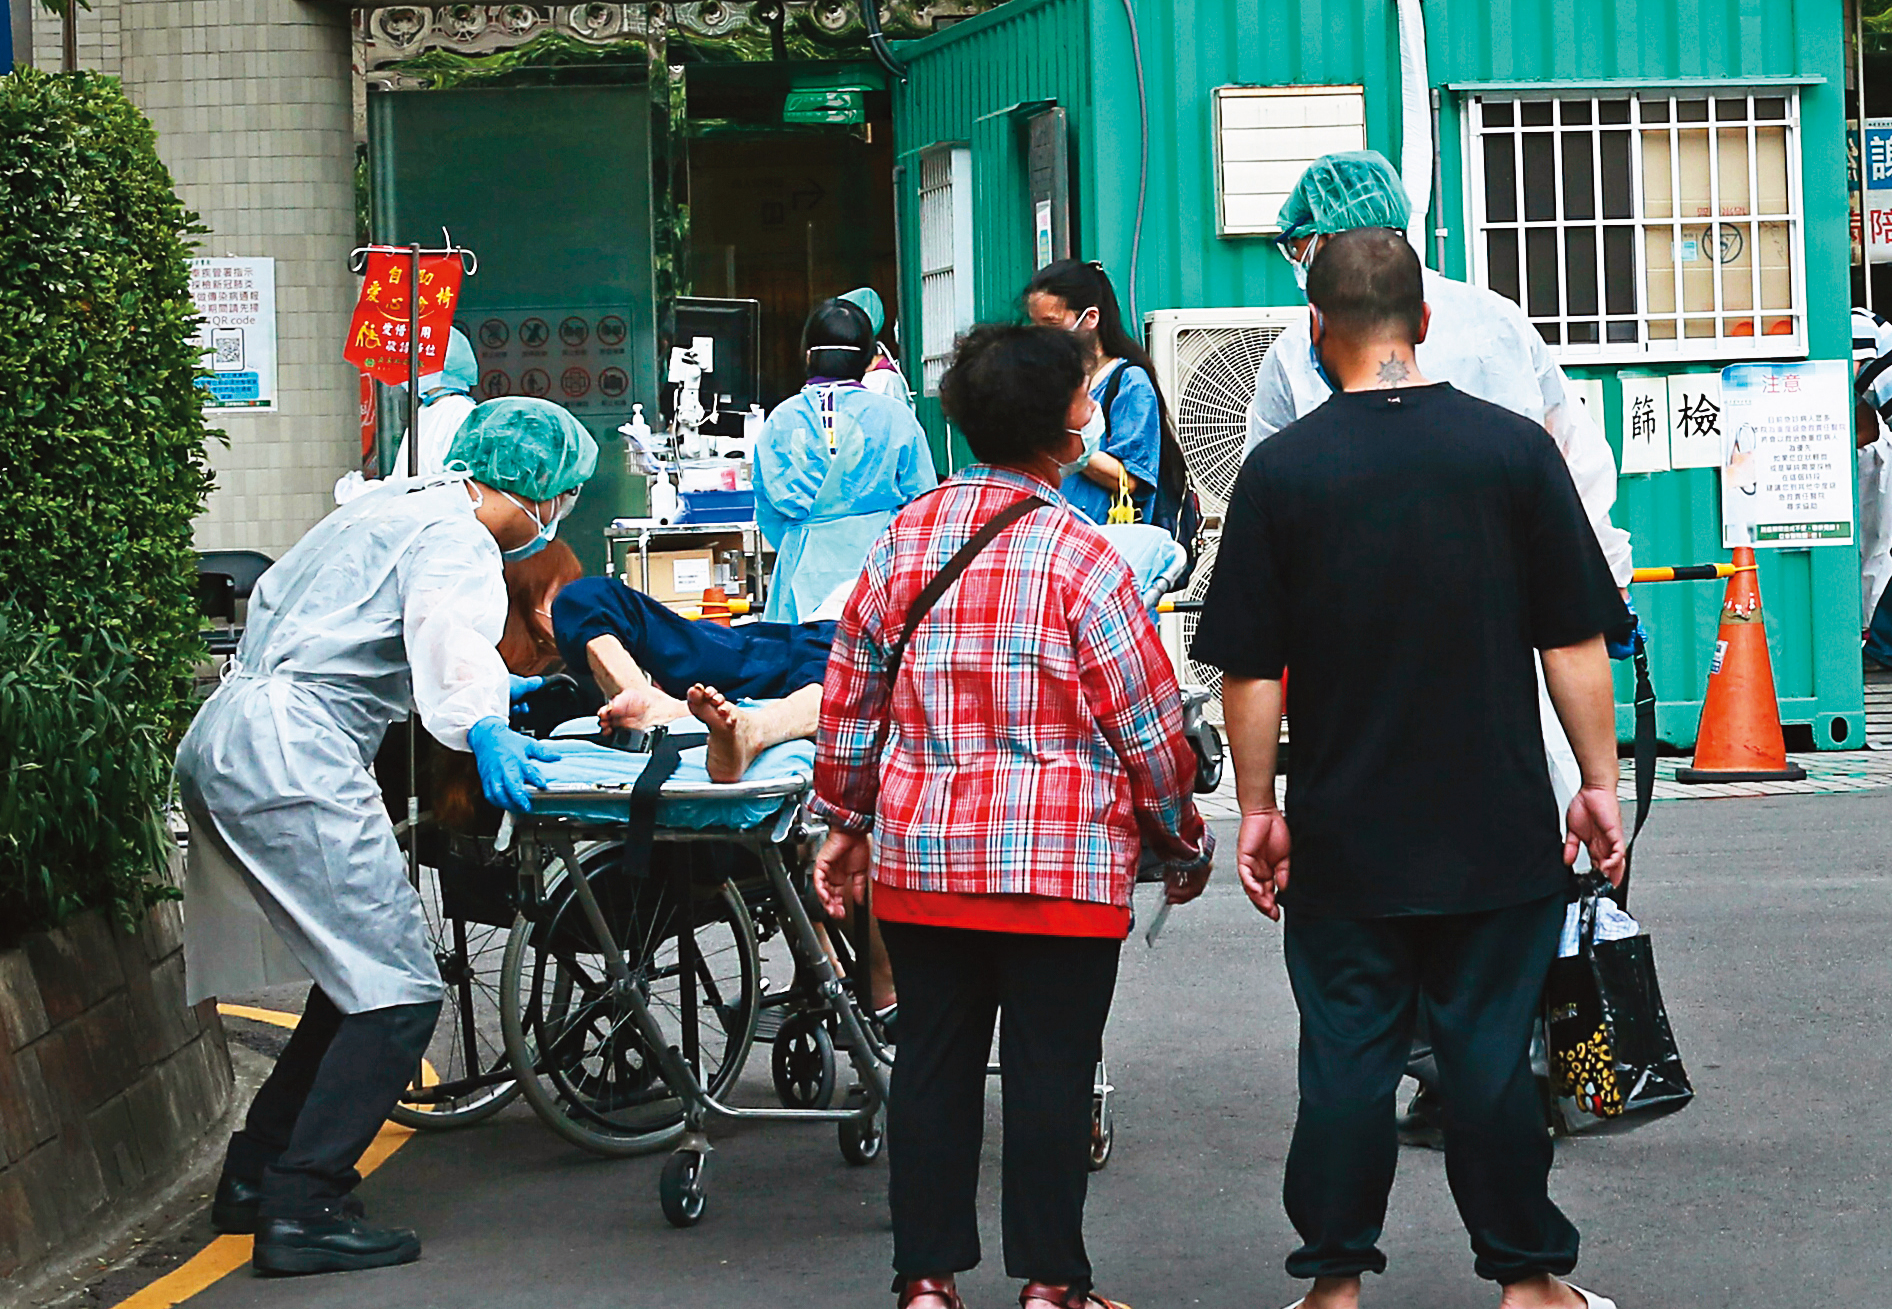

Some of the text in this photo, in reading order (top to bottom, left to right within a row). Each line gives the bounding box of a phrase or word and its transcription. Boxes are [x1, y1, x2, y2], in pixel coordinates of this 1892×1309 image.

[231, 316, 256, 326] code
[1762, 374, 1802, 393] 注意
[1631, 393, 1721, 445] 篩檢
